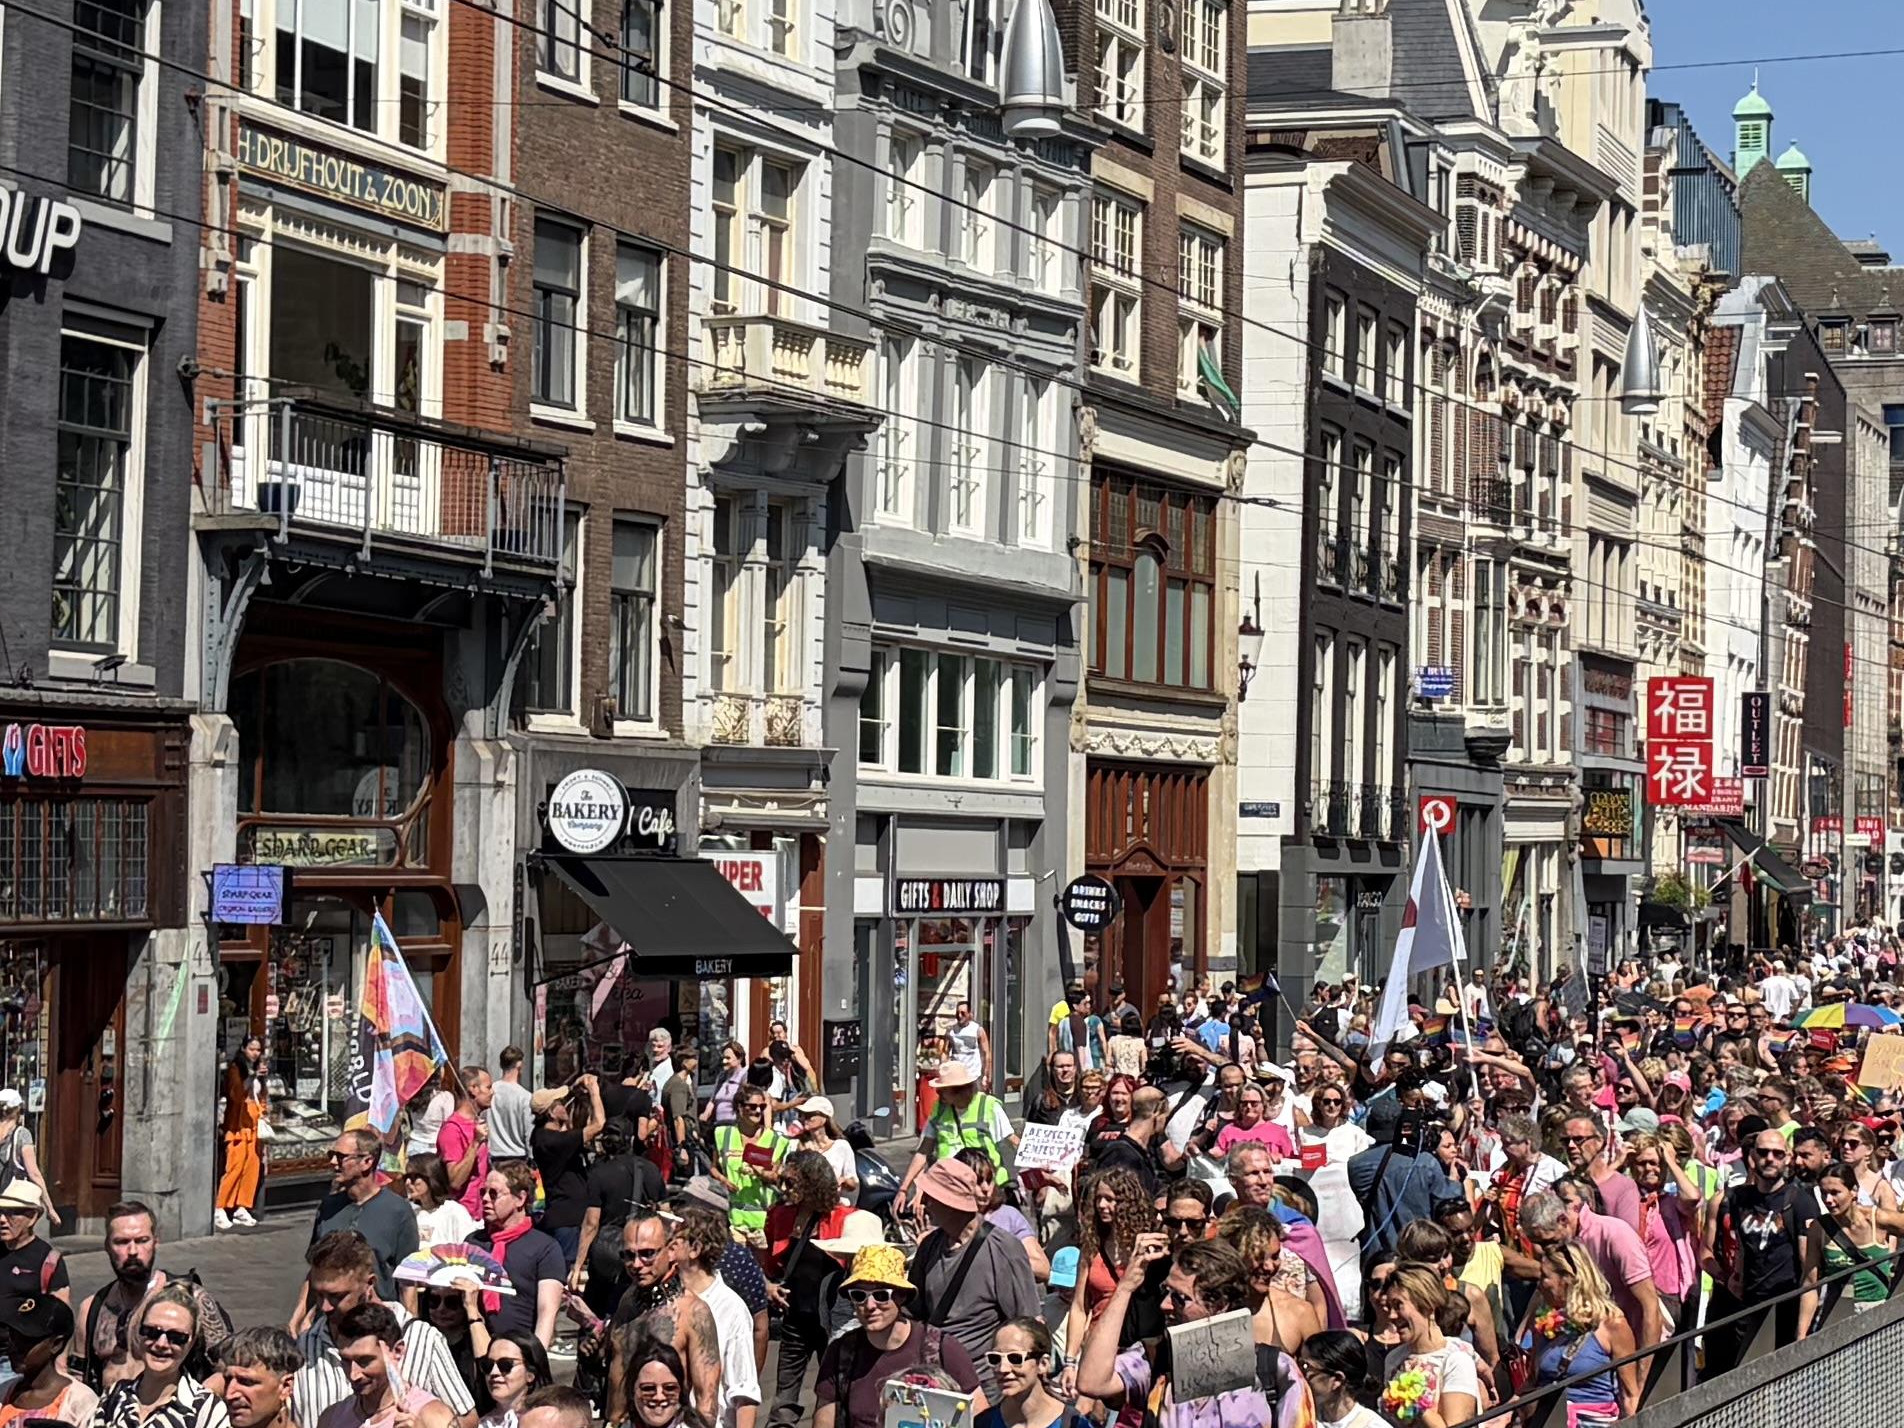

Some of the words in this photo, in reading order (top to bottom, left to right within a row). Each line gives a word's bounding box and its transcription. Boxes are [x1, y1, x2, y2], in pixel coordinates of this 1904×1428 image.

[256, 133, 365, 198] DRIJFHOUT
[380, 173, 433, 220] ZOON
[1749, 696, 1763, 765] OUTLET
[26, 724, 86, 778] GIFTS
[580, 789, 594, 802] The
[552, 801, 622, 821] BAKERY
[637, 806, 676, 847] Café
[261, 831, 321, 861] SHARP
[324, 836, 373, 861] GEAR
[713, 860, 765, 892] UPER
[900, 881, 930, 909] GIFTS
[931, 883, 941, 910] &
[942, 881, 972, 910] DAILY
[974, 881, 1000, 909] SHOP
[1070, 898, 1106, 911] SNACKS
[1071, 884, 1107, 898] DRINKS
[1074, 912, 1100, 924] GIFTS
[695, 958, 733, 974] BAKERY
